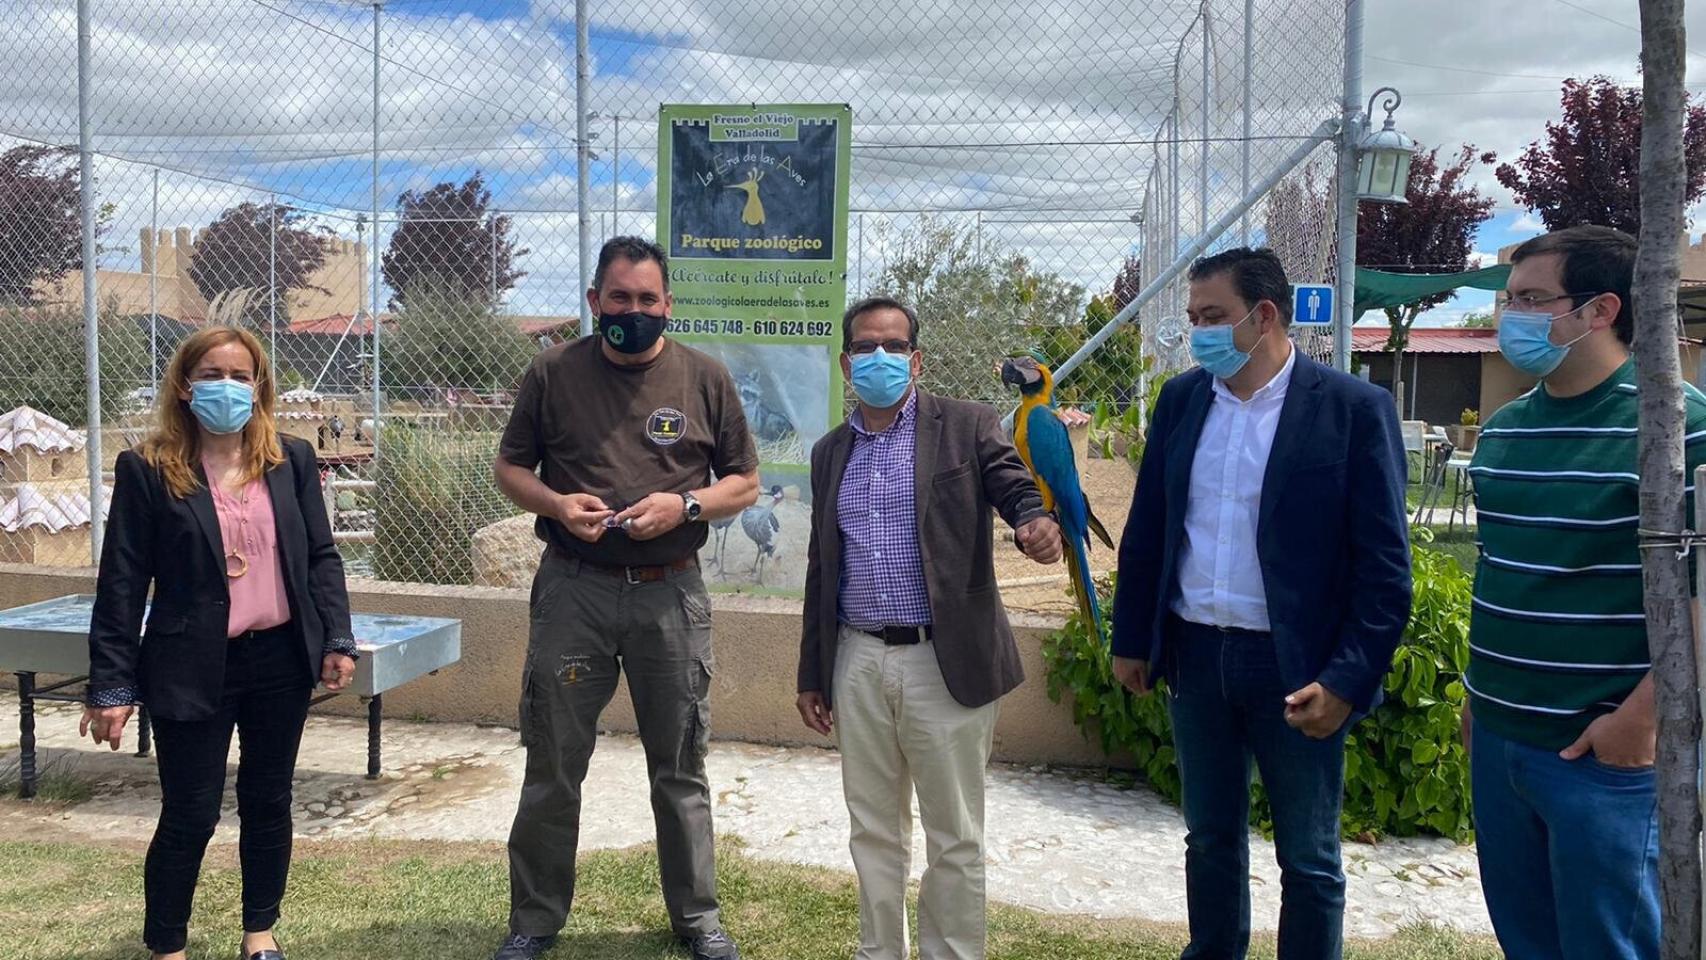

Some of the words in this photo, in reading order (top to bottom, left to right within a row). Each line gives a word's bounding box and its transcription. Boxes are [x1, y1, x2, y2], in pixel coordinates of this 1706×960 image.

[714, 114, 750, 124] Fresno
[753, 114, 762, 124] el
[766, 114, 793, 126] Viejo
[725, 129, 780, 138] Valladolid
[696, 171, 713, 187] La
[713, 152, 740, 175] Era
[743, 144, 757, 162] de
[761, 144, 775, 165] las
[776, 155, 807, 187] Aves
[681, 234, 740, 251] Parque
[745, 235, 822, 252] zoológico
[741, 275, 749, 286] y
[666, 319, 690, 333] 626
[694, 320, 718, 334] 645
[721, 320, 743, 335] 748
[754, 321, 777, 335] 610
[780, 321, 804, 335] 624
[807, 321, 832, 336] 692
